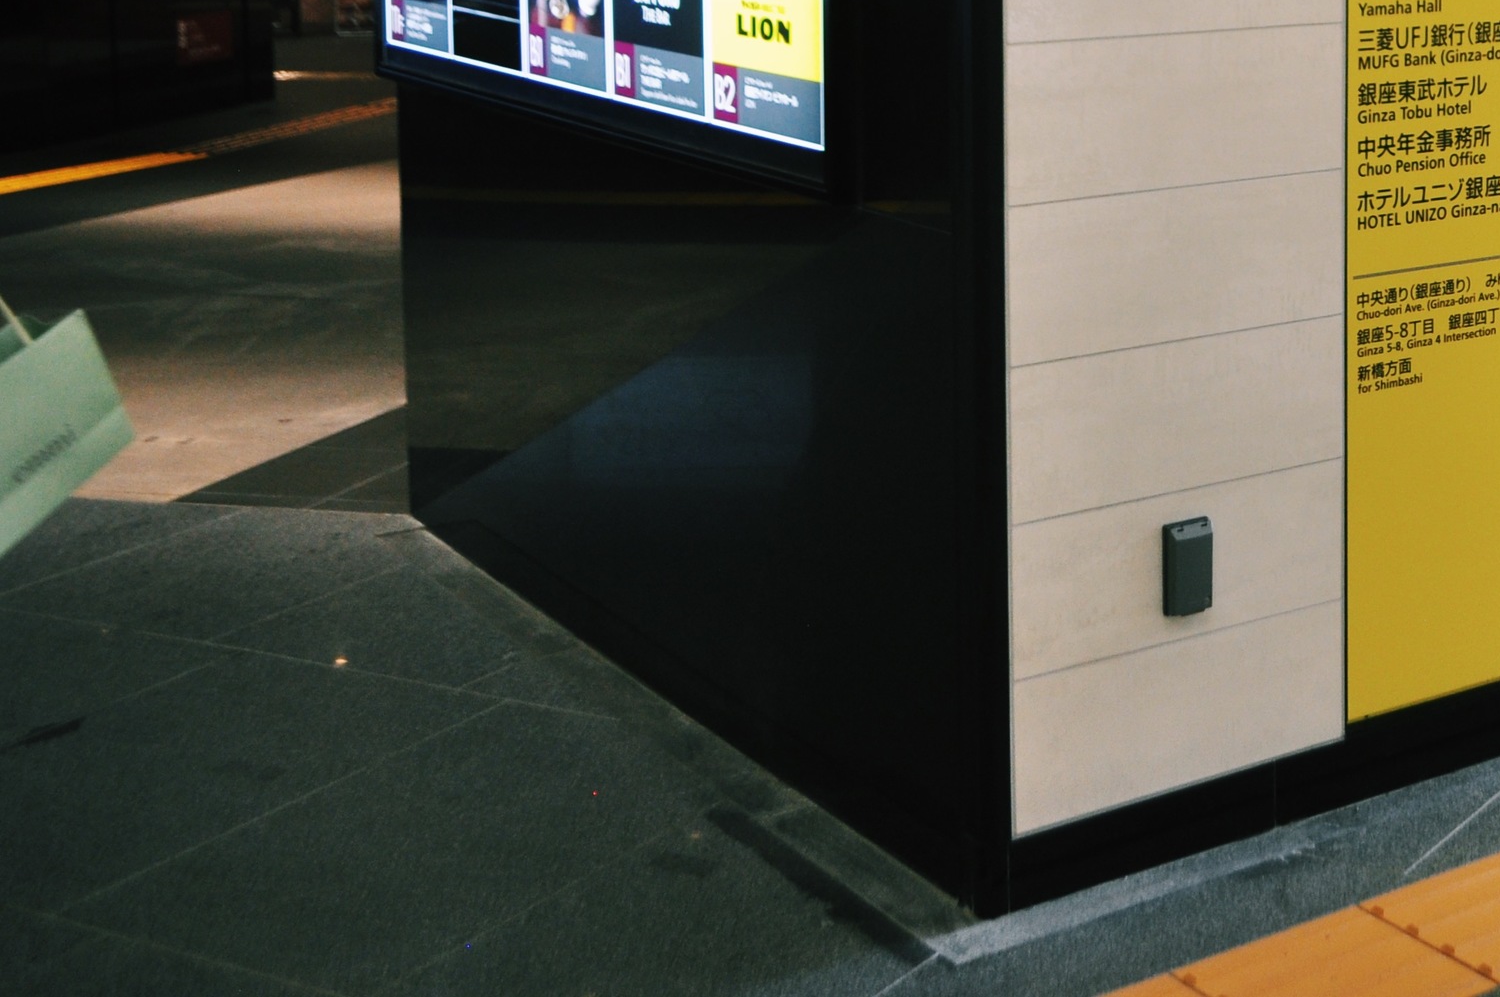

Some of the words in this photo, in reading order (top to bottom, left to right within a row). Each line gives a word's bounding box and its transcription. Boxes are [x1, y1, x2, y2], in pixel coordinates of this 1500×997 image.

[1358, 0, 1412, 17] Yamaha
[737, 13, 792, 44] LION
[1358, 54, 1400, 70] MUFG
[1404, 51, 1437, 68] Bank
[714, 72, 736, 114] B2
[1358, 74, 1487, 107] 銀座東武ホテル
[1358, 109, 1396, 124] Ginza
[1400, 105, 1432, 121] Tobu
[1437, 100, 1472, 117] Hotel
[1358, 124, 1491, 160] 中央年金事務所
[1358, 162, 1392, 178] Chuo
[1396, 156, 1445, 173] Pension
[1449, 151, 1487, 168] Office
[1358, 212, 1401, 230] HOTEL
[1405, 206, 1447, 225] UNIZO
[1356, 305, 1402, 321] Chuo-dori
[1405, 302, 1425, 314] Ave.
[1427, 293, 1476, 312] (Ginza-dori
[1478, 288, 1500, 302] Ave.)
[1356, 318, 1434, 346] 銀座5-8丁目
[1357, 343, 1384, 358] Ginza
[1386, 340, 1404, 354] 5-8,
[1406, 335, 1433, 350] Ginza
[1435, 334, 1441, 345] 4
[1443, 325, 1497, 343] Intersection
[1357, 357, 1412, 382] 新橋方面
[1357, 381, 1372, 394] for
[1375, 373, 1423, 391] Shimbashi
